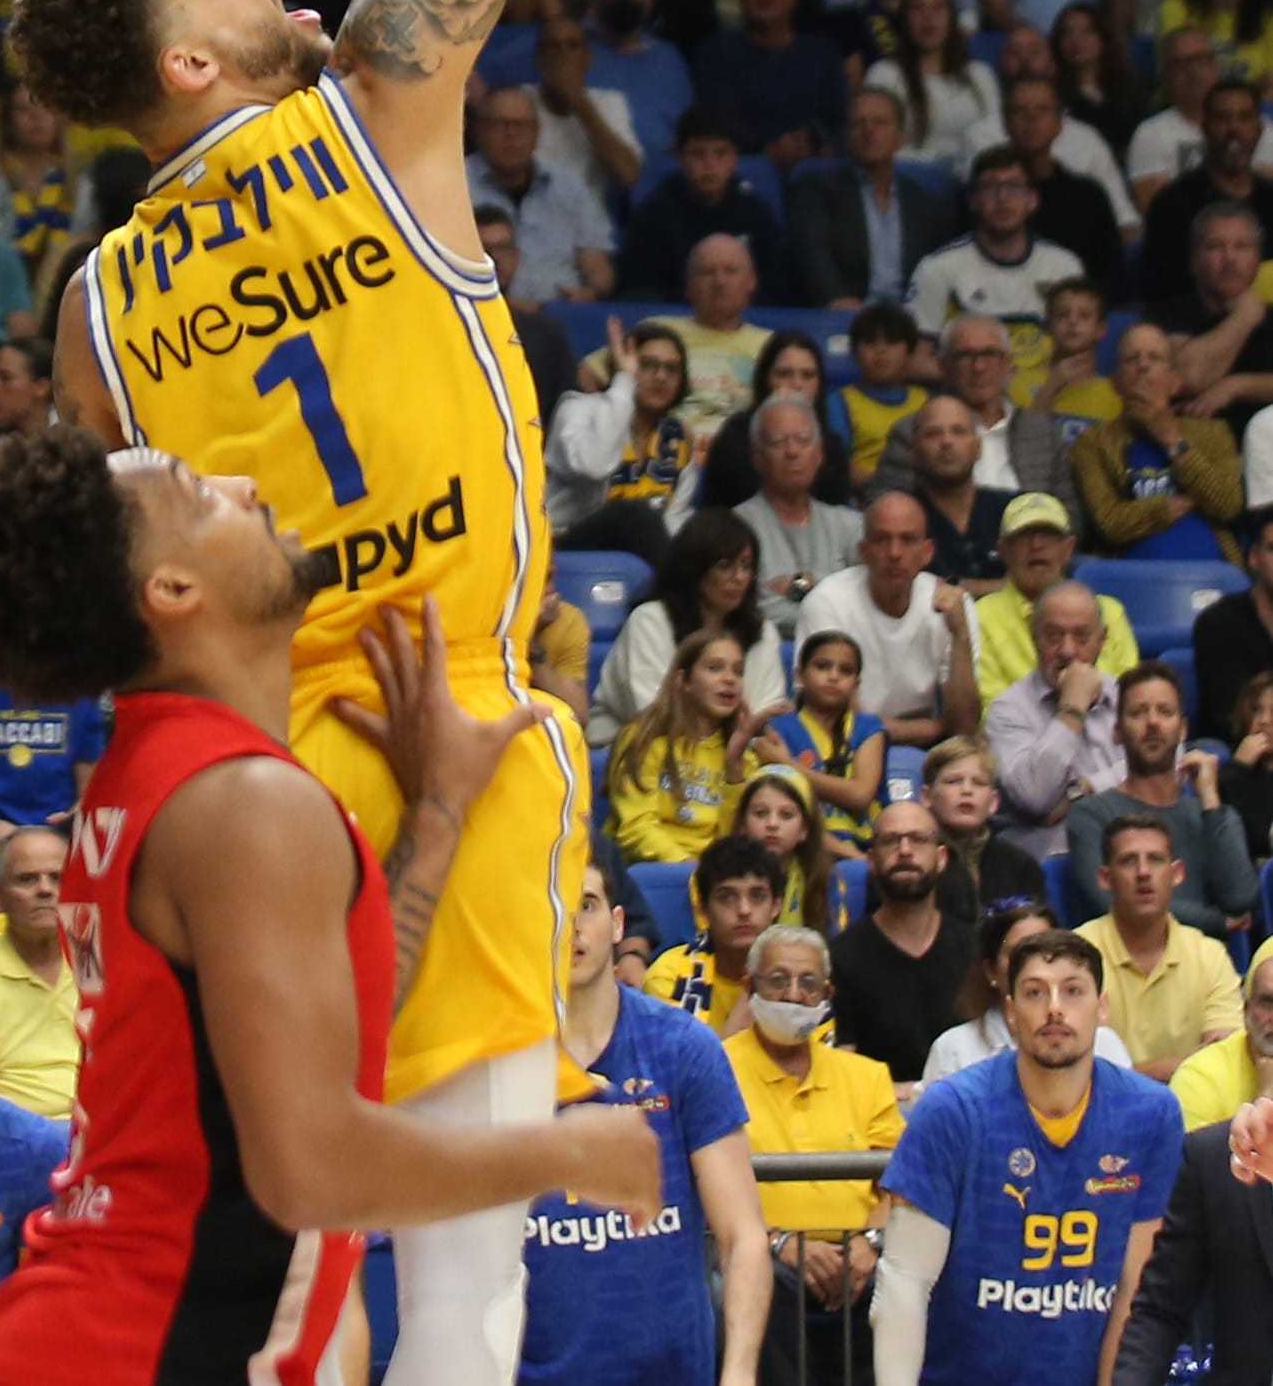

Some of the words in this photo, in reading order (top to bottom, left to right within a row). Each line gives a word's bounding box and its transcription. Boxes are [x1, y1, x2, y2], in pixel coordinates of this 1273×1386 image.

[116, 136, 348, 314] ווילבקין
[126, 235, 395, 383] weSure
[253, 331, 368, 507] 1
[1021, 1210, 1098, 1270] 99
